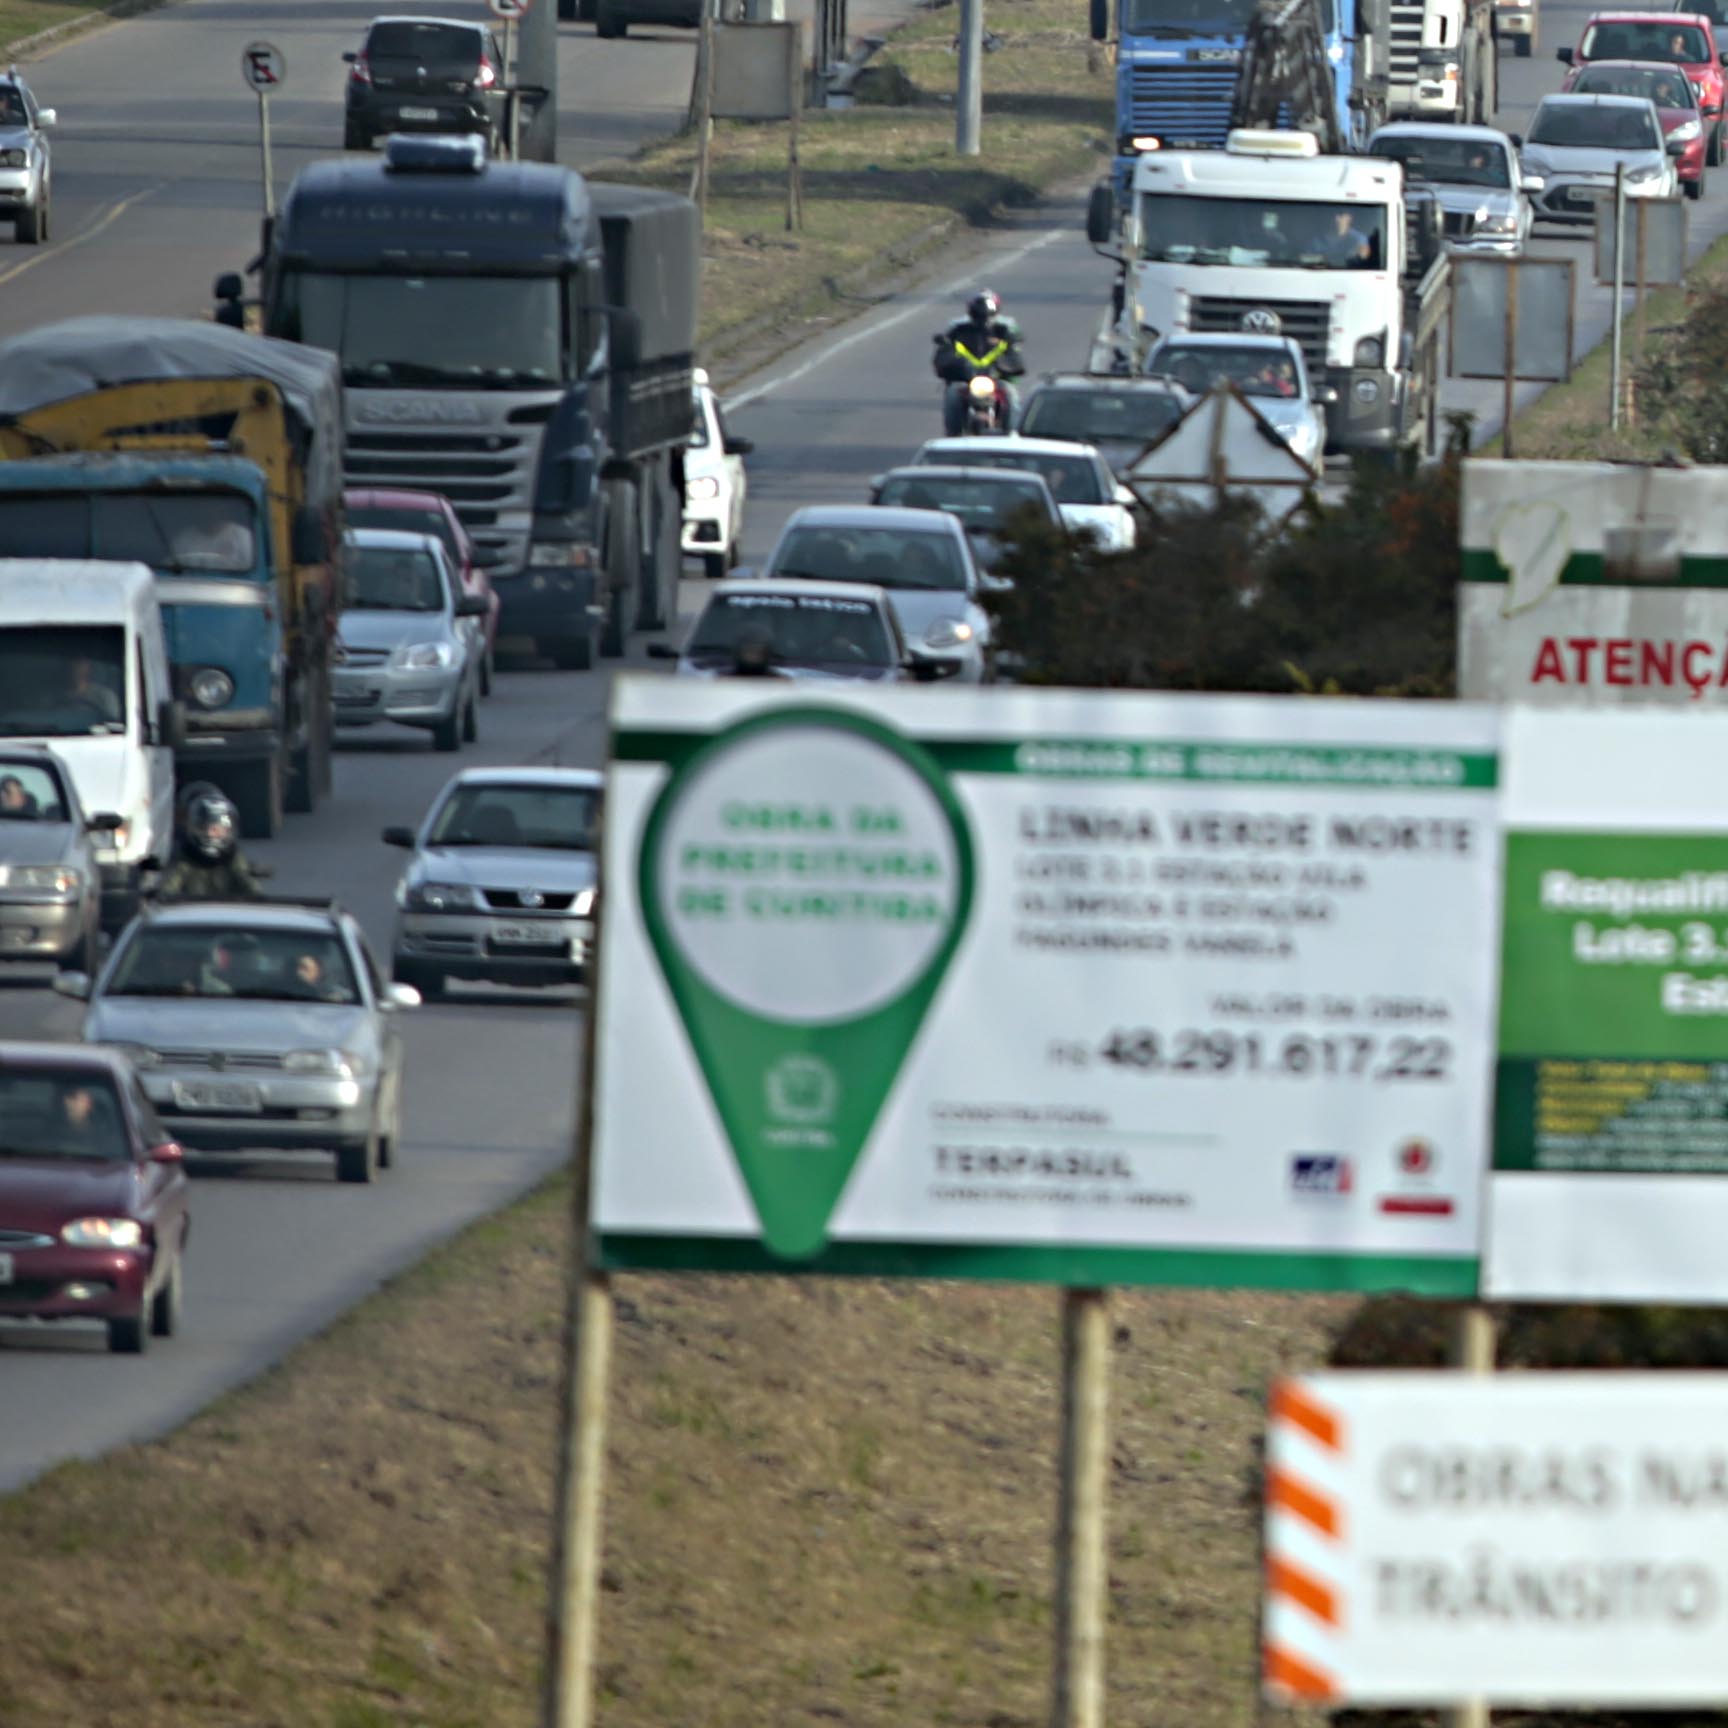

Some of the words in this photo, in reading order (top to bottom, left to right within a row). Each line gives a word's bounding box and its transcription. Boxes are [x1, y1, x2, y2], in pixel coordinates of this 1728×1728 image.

[722, 803, 833, 832] OBRA
[853, 804, 903, 834] DA
[1018, 805, 1159, 846] LINHA
[1170, 810, 1314, 849] VERDE
[1328, 815, 1474, 854] NORTE
[683, 843, 939, 877] PREFEITURA
[679, 884, 728, 918] DE
[745, 888, 943, 922] CURITIBA
[1576, 922, 1675, 965] Lote
[1381, 1444, 1620, 1514] OBRAS
[1373, 1541, 1719, 1624] TRÂNSITO
